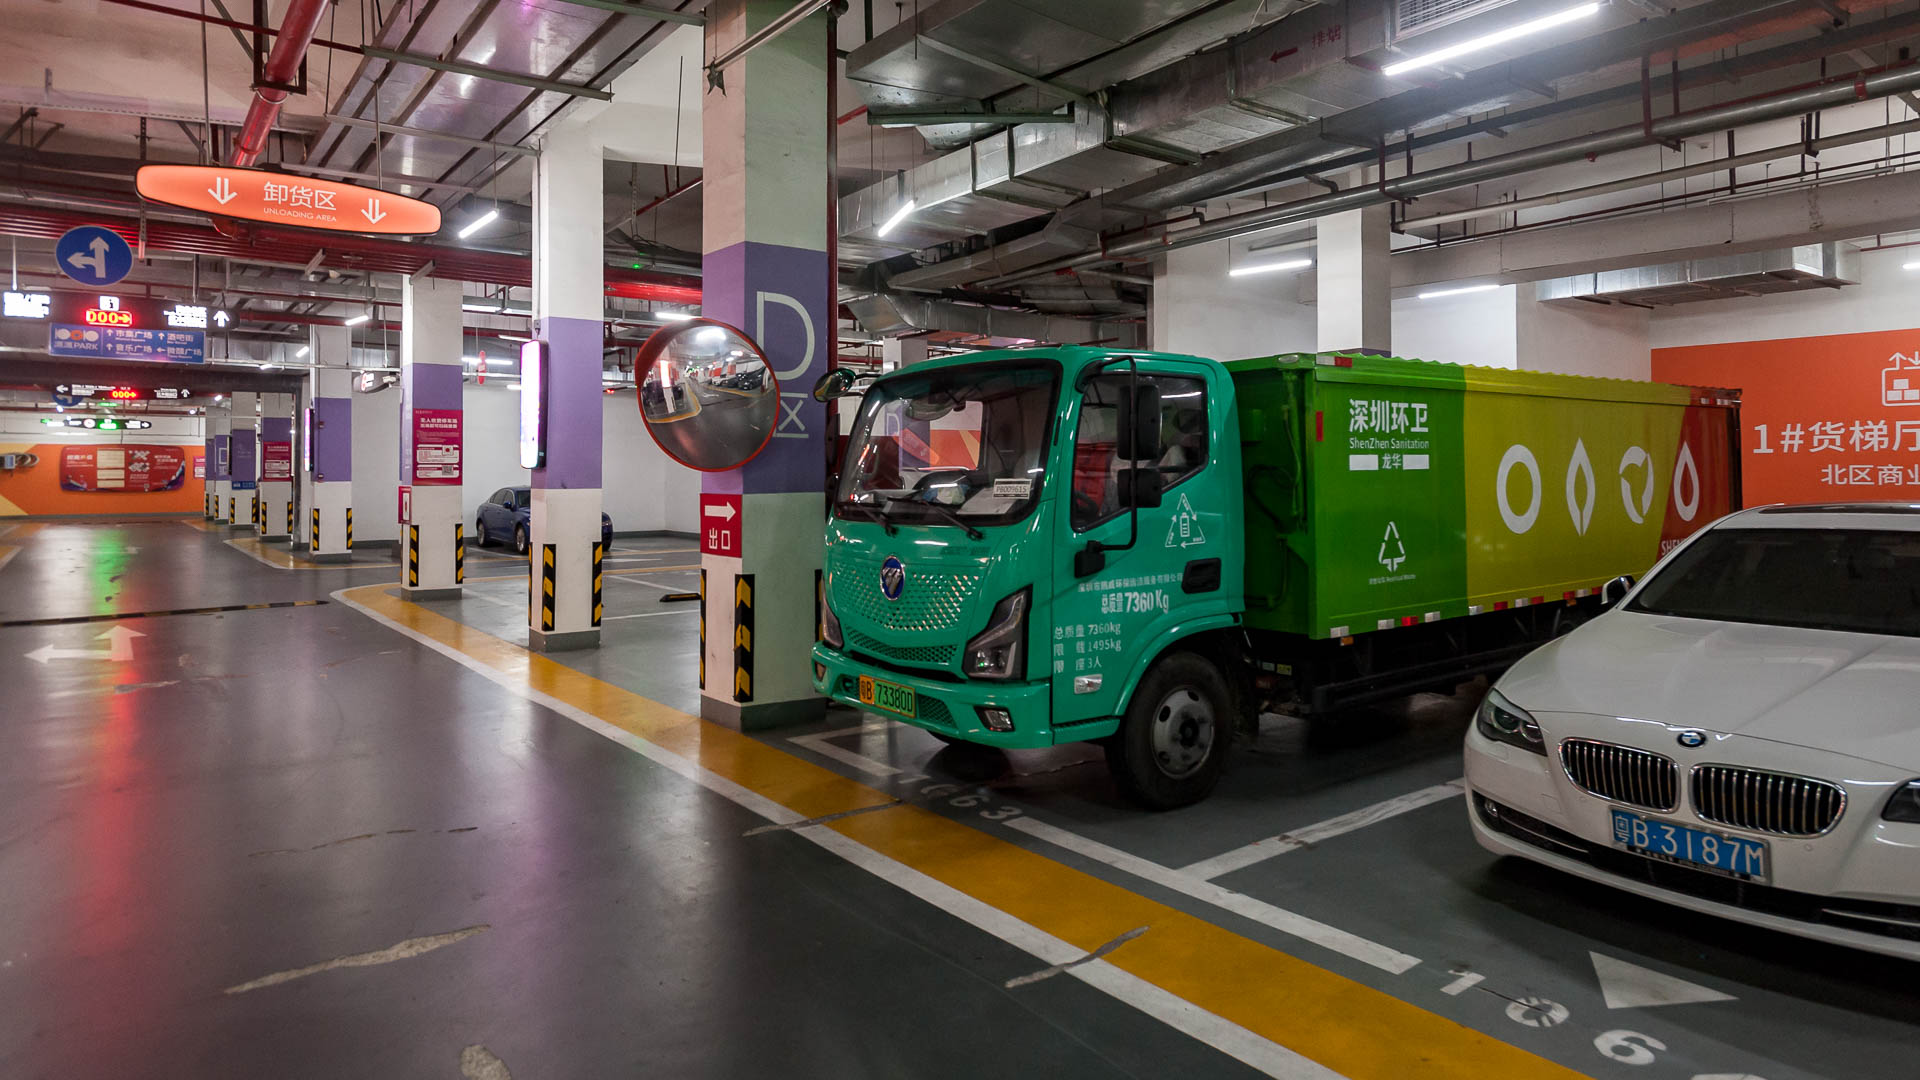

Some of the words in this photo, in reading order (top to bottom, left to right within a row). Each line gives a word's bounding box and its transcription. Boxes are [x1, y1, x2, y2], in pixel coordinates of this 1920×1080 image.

[264, 181, 337, 211] 卸货区
[263, 207, 314, 220] UNLOADING
[316, 214, 337, 222] AREA
[756, 291, 815, 381] D
[1348, 398, 1429, 434] 深圳环卫
[1349, 437, 1389, 449] ShenZhen
[1391, 437, 1429, 449] Sanitation
[1382, 453, 1402, 469] 龙华
[708, 527, 731, 550] 出口
